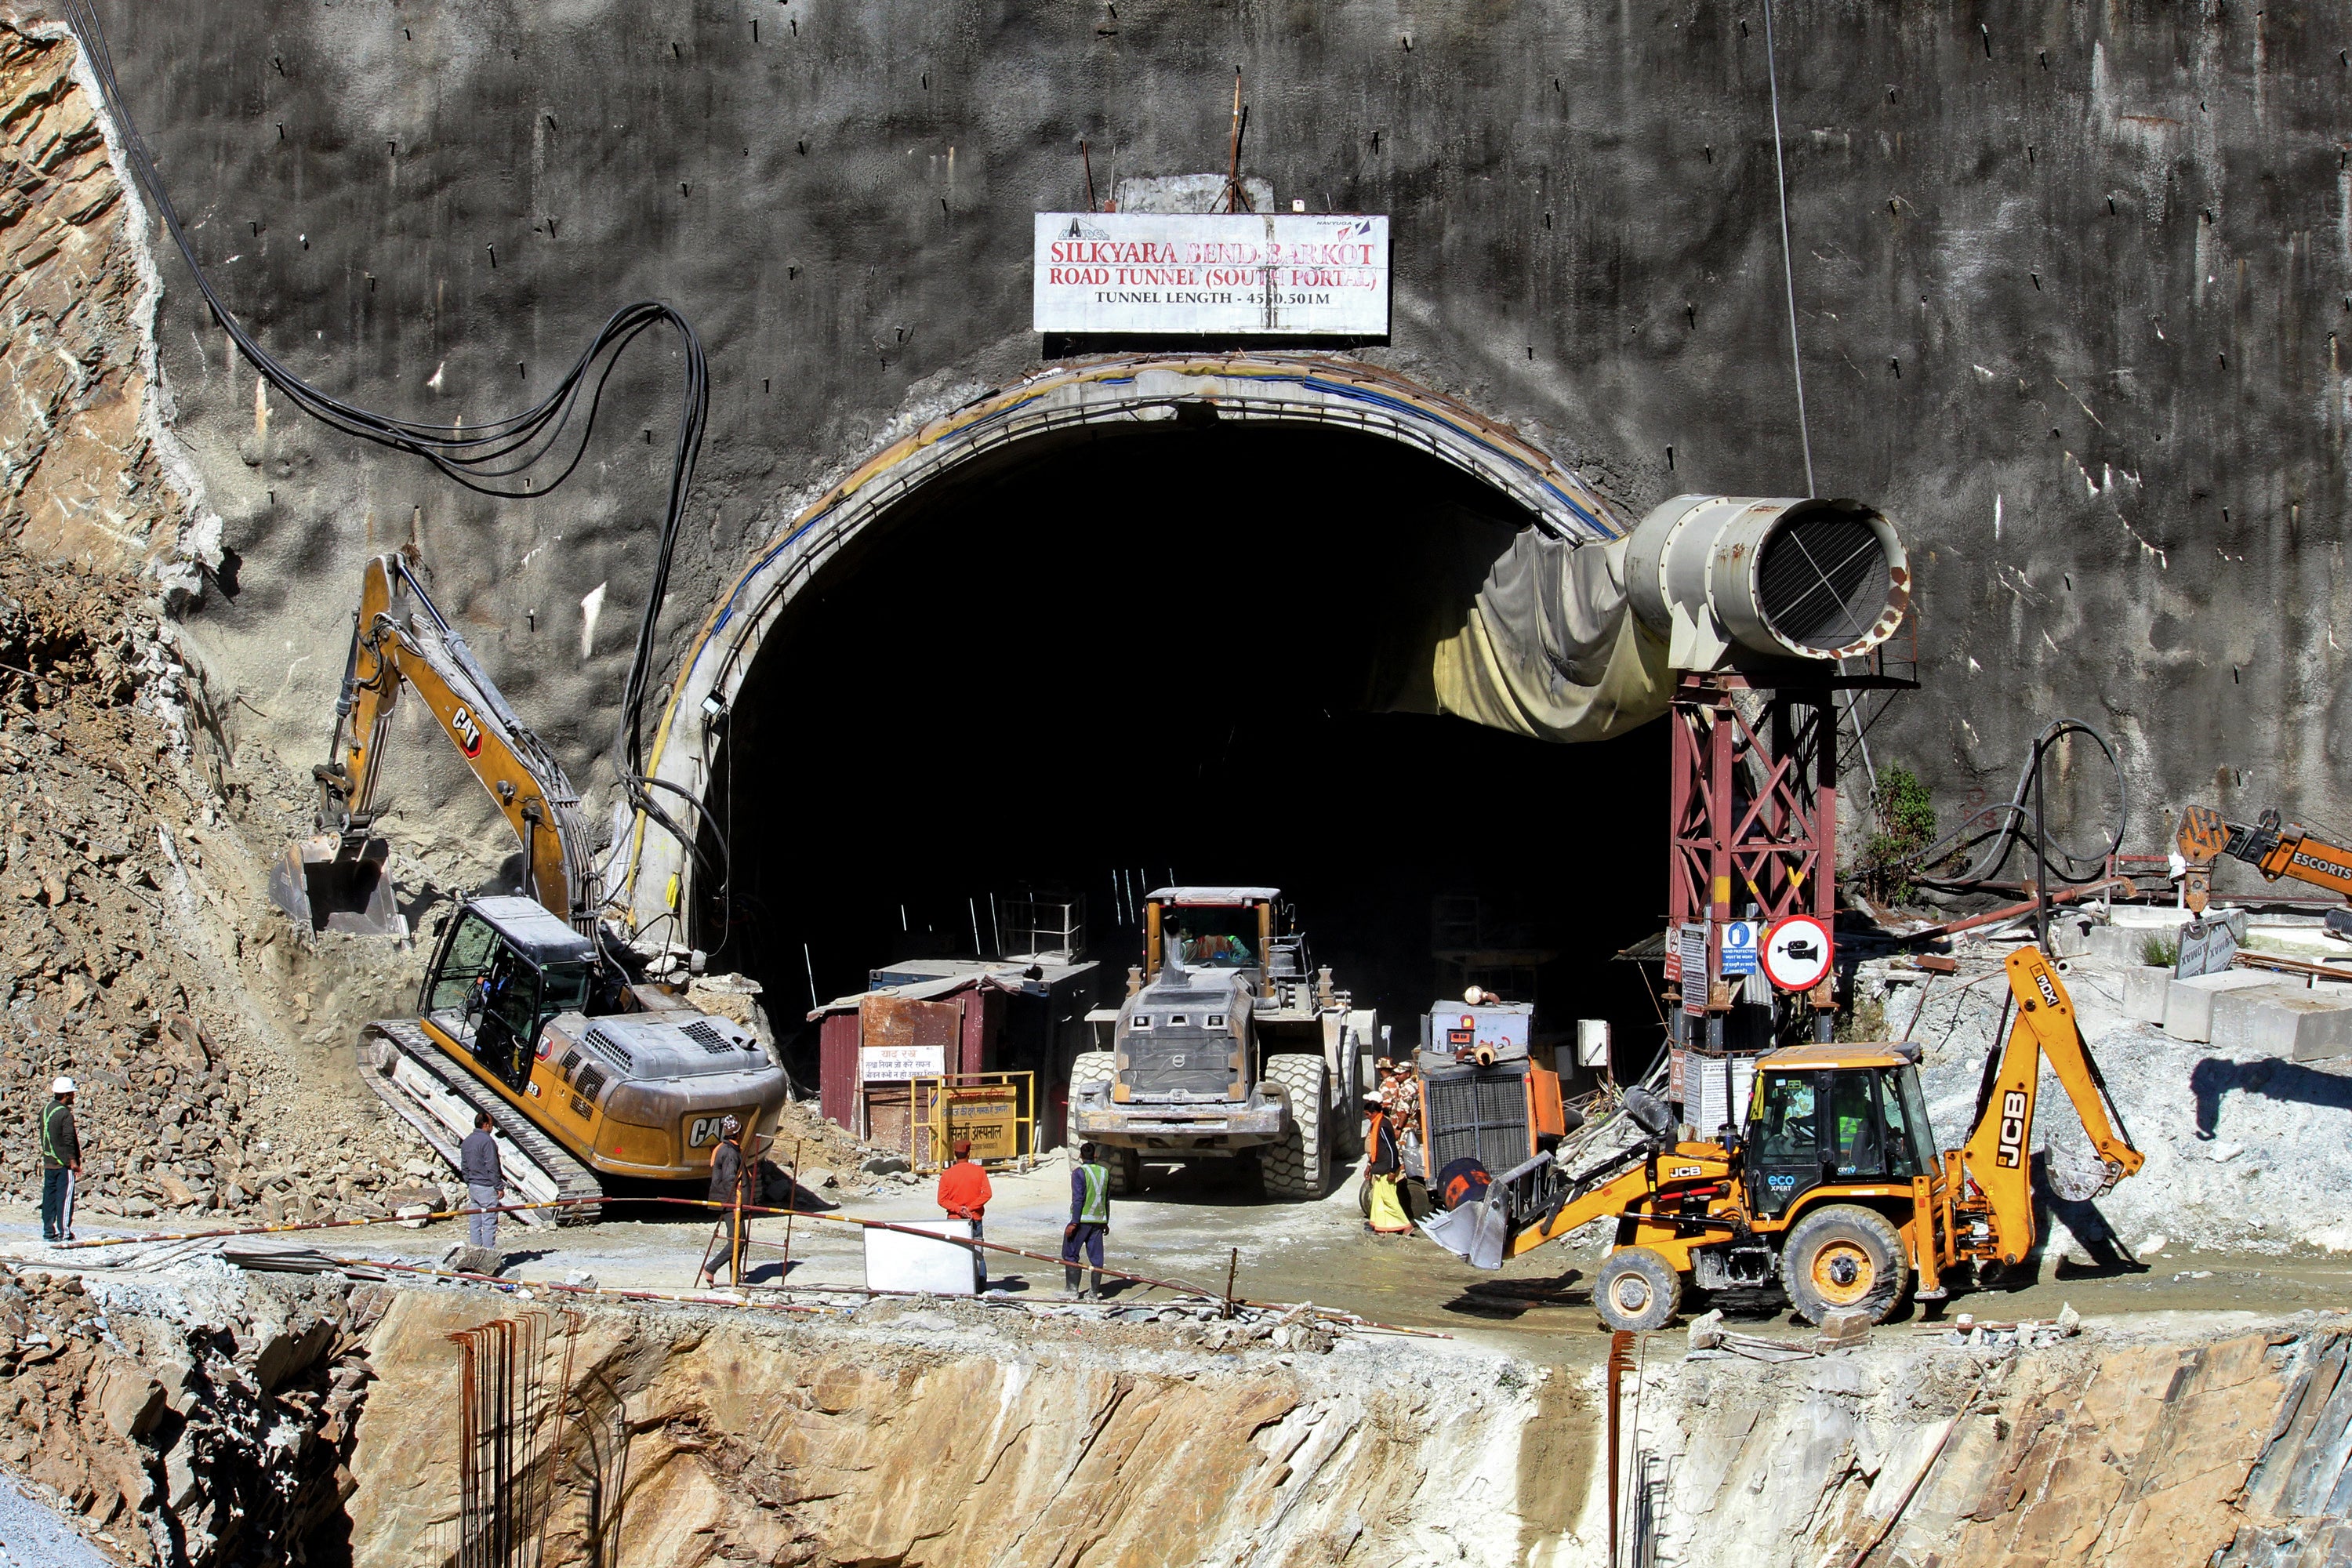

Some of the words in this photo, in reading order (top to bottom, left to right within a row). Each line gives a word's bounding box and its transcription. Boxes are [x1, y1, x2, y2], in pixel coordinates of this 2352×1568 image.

[1051, 241, 1178, 263] SILKYARA
[1049, 267, 1110, 285] ROAD
[1116, 268, 1200, 286] TUNNEL
[1205, 268, 1285, 290] (SOUTH
[1290, 269, 1377, 292] PORTAL)
[1095, 292, 1161, 303] TUNNEL
[1167, 292, 1232, 304] LENGTH
[452, 707, 480, 748] CAT
[2292, 851, 2352, 880] ESCORTS
[2036, 975, 2057, 1004] 3DX
[971, 1125, 1003, 1141] अस्पताल
[2002, 1093, 2026, 1167] JCB
[1670, 1166, 1701, 1178] JCB
[1768, 1175, 1795, 1185] eco
